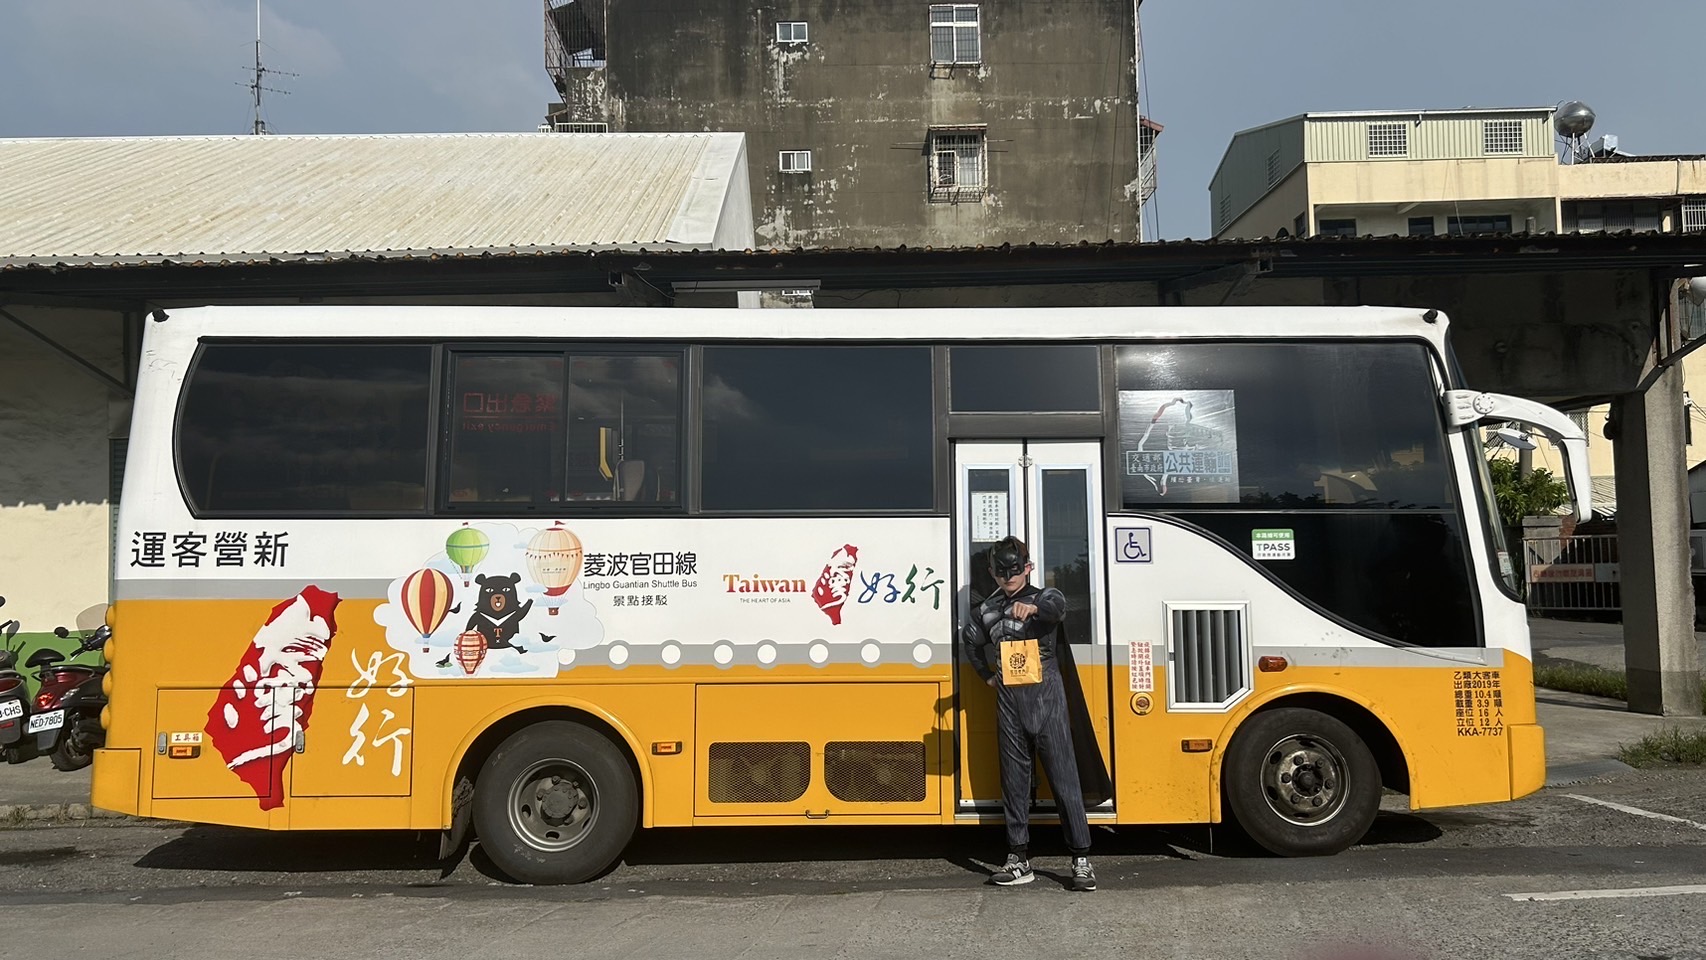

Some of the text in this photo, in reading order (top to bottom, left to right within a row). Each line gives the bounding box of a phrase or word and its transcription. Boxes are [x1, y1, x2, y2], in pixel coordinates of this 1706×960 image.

[1256, 543, 1291, 551] TPASS
[583, 552, 698, 577] 菱波官田線
[583, 579, 698, 591] Lingbo Guantian Shuttle Bus
[723, 573, 806, 593] Taiwan
[858, 564, 944, 610] 好行
[613, 594, 668, 607] 景點接駁
[1453, 671, 1500, 680] 乙類大客車
[1475, 690, 1491, 698] 10.4
[1477, 699, 1489, 707] 3.9
[1479, 708, 1489, 717] 16
[1495, 708, 1503, 717] 人
[30, 714, 62, 729] NED-7805
[1480, 718, 1490, 726] 12
[1495, 718, 1503, 726] 人
[1457, 727, 1503, 736] KKA-7737
